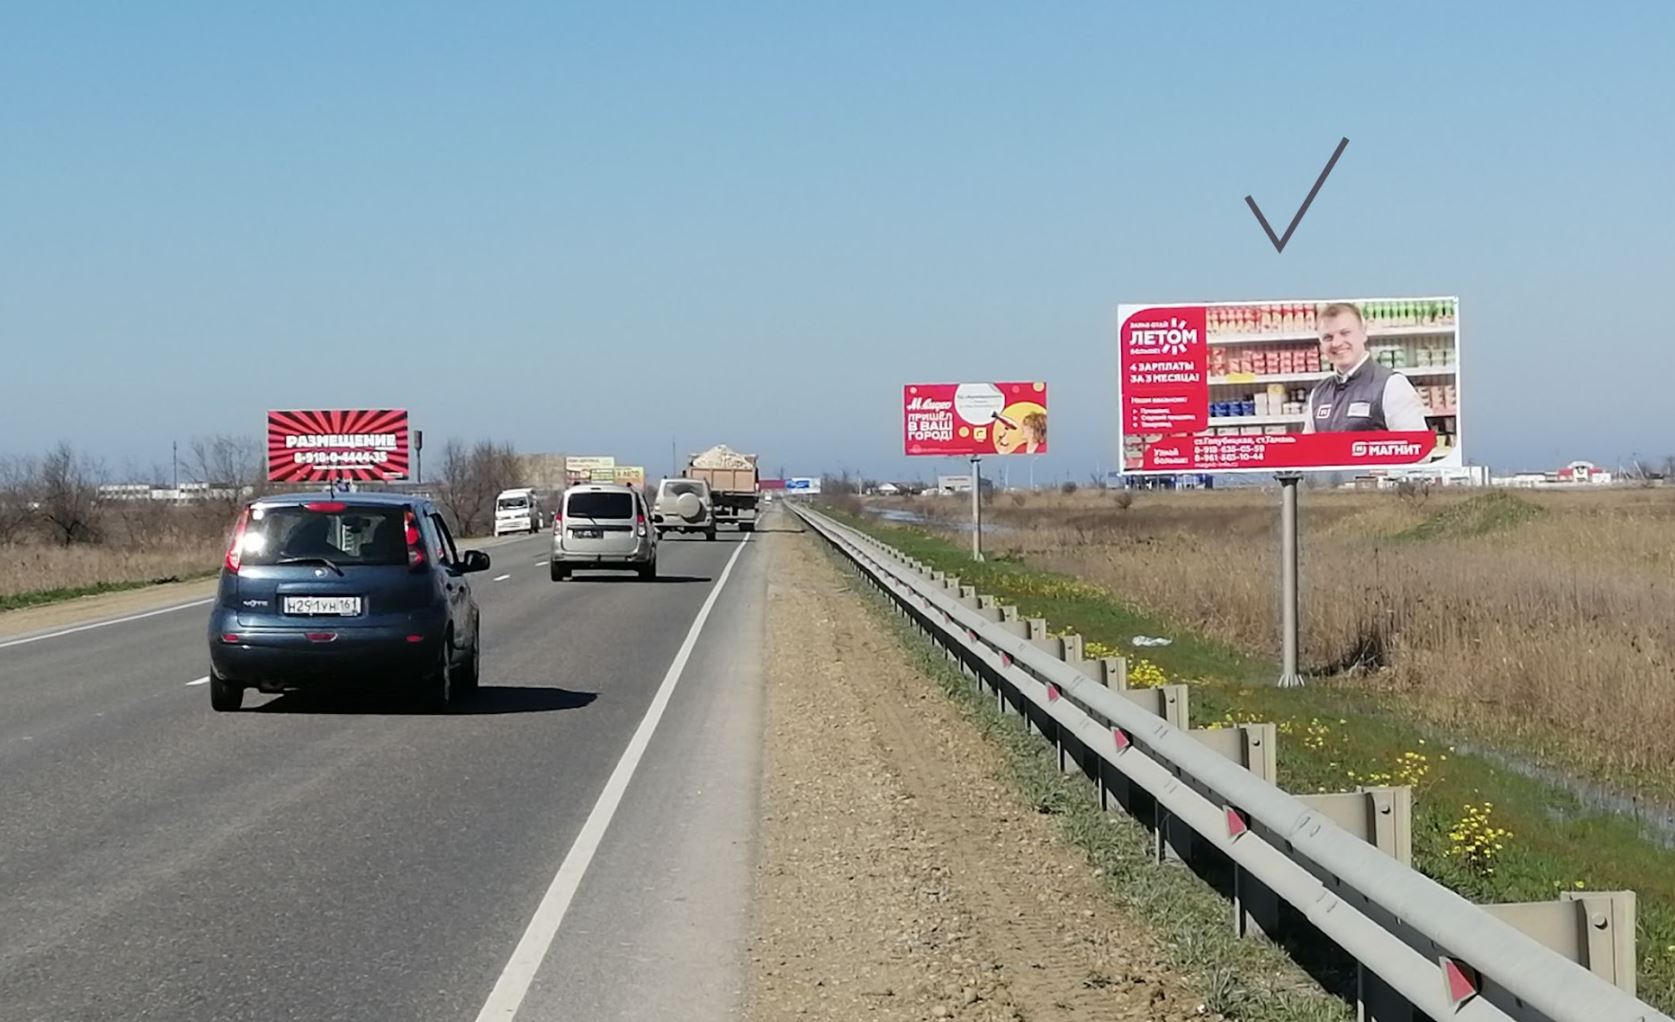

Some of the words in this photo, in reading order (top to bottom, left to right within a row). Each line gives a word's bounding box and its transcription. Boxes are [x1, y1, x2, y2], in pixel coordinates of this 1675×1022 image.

[1130, 330, 1197, 345] ЛЕТОМ
[1129, 363, 1137, 372] 4
[1138, 362, 1194, 371] ЗАРПЛАТЫ
[1130, 374, 1145, 383] ЗА
[1145, 374, 1152, 383] 3
[1153, 373, 1200, 383] МЕСЯЦА!
[908, 421, 918, 431] В
[920, 421, 953, 431] ВАШ
[286, 434, 396, 449] РАЗМЕЩЕНИЕ
[909, 431, 952, 442] ГОРОД!
[1368, 444, 1422, 456] МАГНИТ
